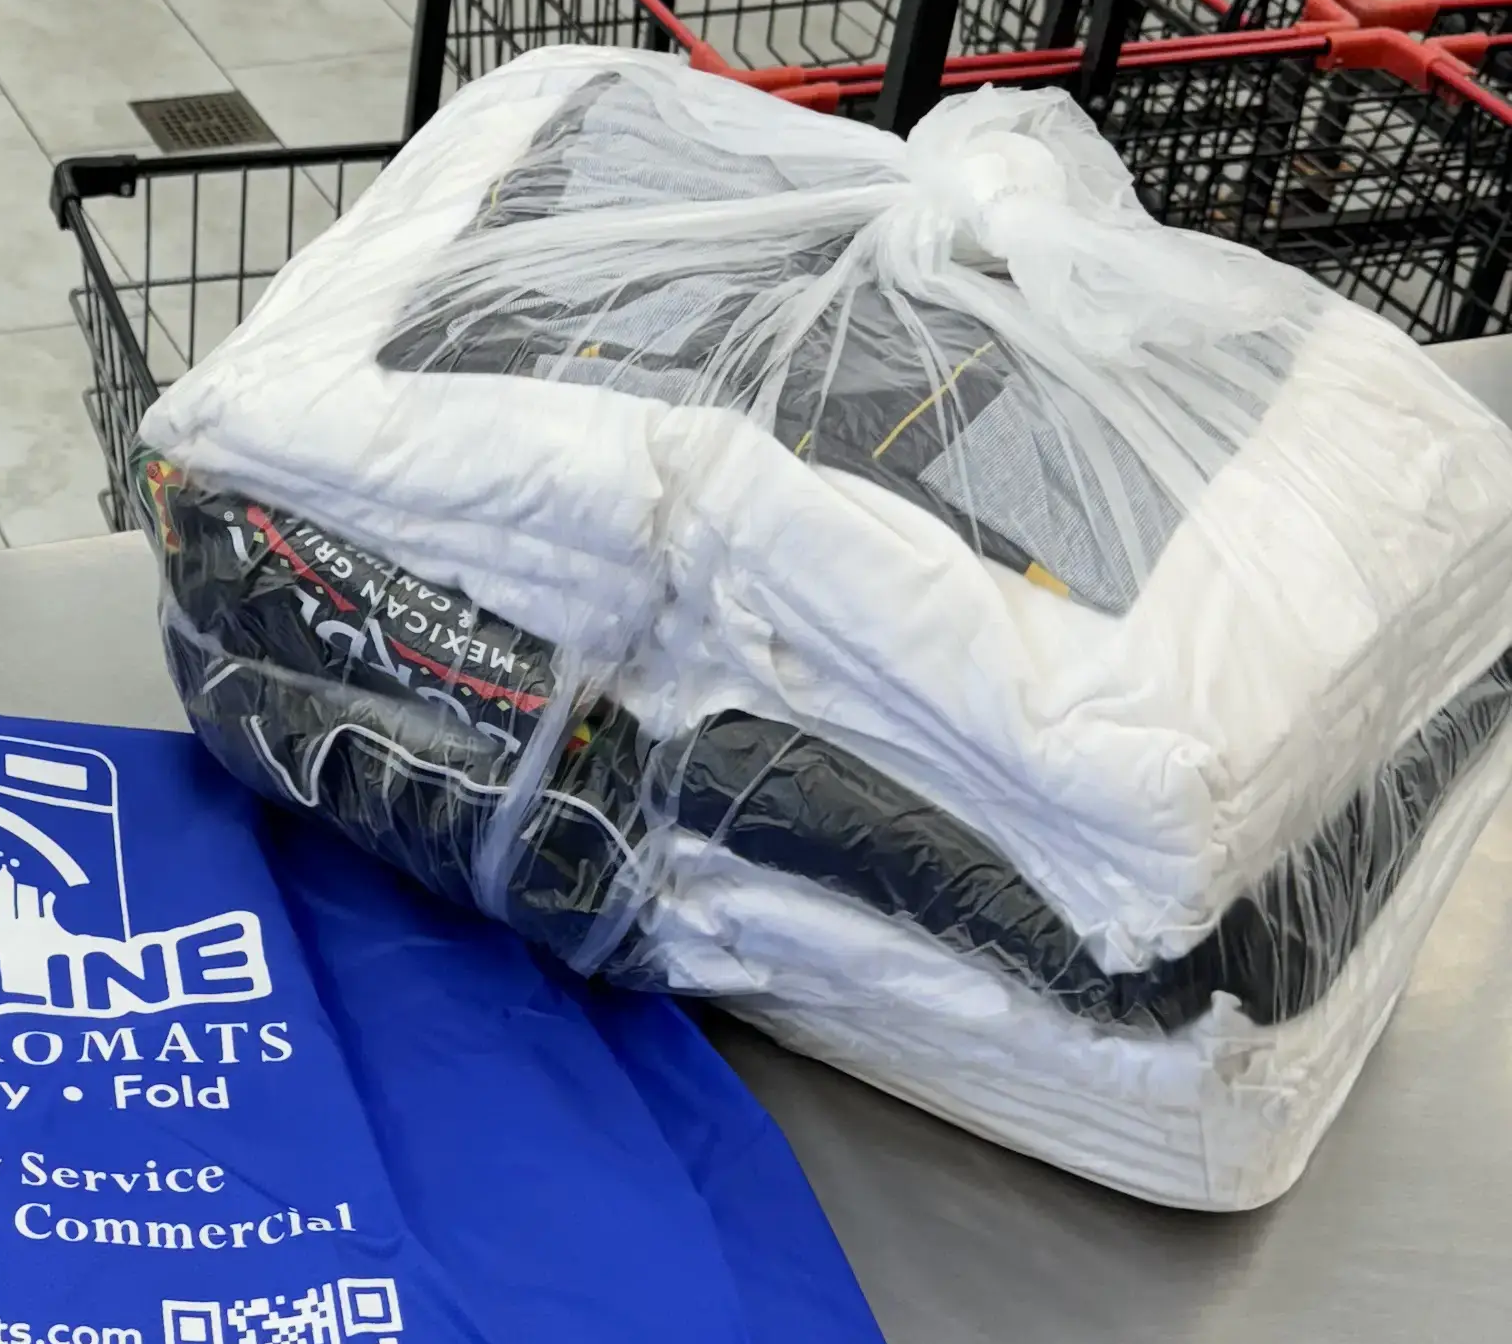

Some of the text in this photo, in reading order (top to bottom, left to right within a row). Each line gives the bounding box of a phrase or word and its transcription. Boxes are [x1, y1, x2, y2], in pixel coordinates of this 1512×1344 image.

[360, 579, 516, 674] MEXICAN
[458, 608, 473, 629] &
[113, 1074, 230, 1109] Fold
[21, 1151, 225, 1193] Service
[14, 1202, 355, 1250] Commercial
